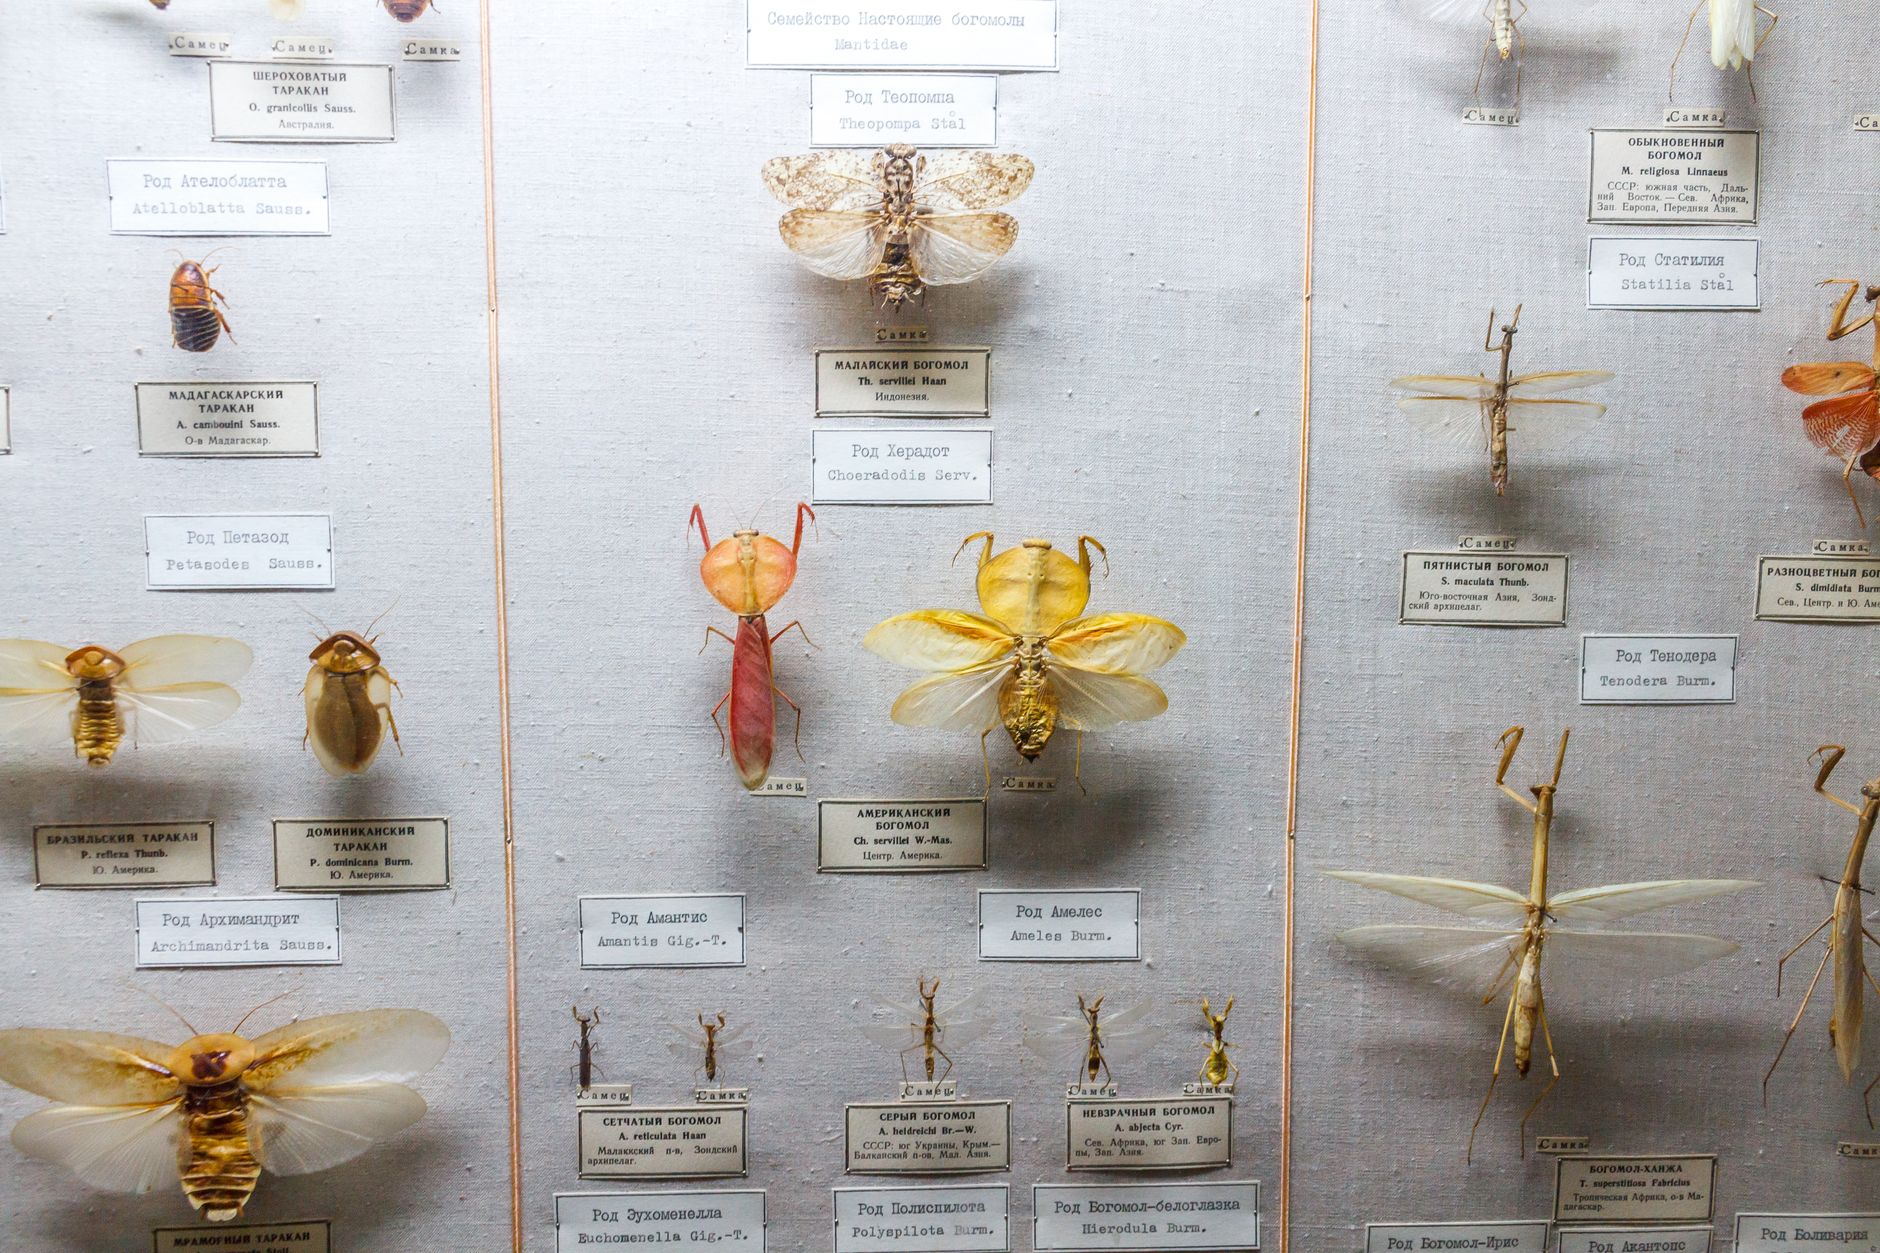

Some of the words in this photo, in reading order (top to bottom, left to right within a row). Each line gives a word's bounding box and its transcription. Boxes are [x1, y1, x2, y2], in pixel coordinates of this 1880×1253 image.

[767, 11, 850, 26] Семейство
[859, 11, 942, 27] Настоящие
[951, 12, 1025, 27] богомолы
[174, 36, 227, 52] Самец
[274, 40, 326, 55] Самец
[407, 42, 457, 55] Самка
[835, 38, 908, 51] Mantidae
[253, 71, 347, 82] ШЕРОХОВАТЫЙ
[272, 86, 329, 96] ТАРАКАН
[845, 90, 873, 105] Род
[881, 90, 955, 104] Теопомпа
[266, 103, 318, 115] granicollis
[324, 104, 356, 113] Sauss.
[1468, 110, 1514, 124] Самец
[1670, 111, 1718, 122] Самка
[278, 119, 335, 131] Австралия.
[839, 118, 921, 132] Theopompa
[1628, 137, 1725, 148] ОБЫКНОВЕННЫЙ
[1648, 151, 1702, 161] БОГОМОЛ
[1640, 167, 1680, 177] religiosa
[1687, 167, 1728, 177] Linnaeus
[143, 174, 172, 189] Род
[181, 174, 288, 188] Ателоблатта
[1607, 182, 1639, 191] СССР:
[1645, 184, 1678, 192] южная
[1683, 185, 1711, 193] часть,
[1721, 184, 1749, 193] Даль-
[1710, 194, 1749, 204] Африка,
[133, 202, 245, 214] Atelloblatta
[256, 203, 311, 216] Sauss.
[1622, 203, 1659, 214] Европа,
[1664, 203, 1709, 213] Передняя
[1713, 204, 1738, 214] Азия.
[1619, 253, 1646, 267] Род
[1654, 253, 1725, 267] Статилия
[1621, 279, 1691, 290] Statilia
[877, 329, 927, 340] Самка
[835, 361, 909, 371] МАЛАЙСКИЙ
[913, 361, 969, 370] БОГОМОЛ
[858, 377, 874, 386] Th.
[922, 377, 947, 385] Haan
[169, 390, 283, 401] МАДАГАСКАРСКИЙ
[875, 393, 929, 402] Индонезия.
[199, 404, 255, 413] ТАРАКАН
[193, 420, 243, 429] cambouini
[250, 419, 281, 429] Sauss.
[185, 436, 203, 445] О-в
[208, 437, 271, 446] Мадагаскар.
[851, 444, 879, 459] Род
[887, 444, 950, 460] Херадот
[828, 469, 926, 481] Choeradodis
[935, 470, 978, 481] Serv.
[187, 531, 215, 545] Род
[223, 531, 289, 545] Петазод
[1463, 537, 1512, 549] Самец
[1818, 541, 1863, 552] Самка
[166, 559, 250, 570] Petasodes
[268, 558, 322, 570] Sauss.
[1423, 561, 1491, 571] ПЯТНИСТЫЙ
[1497, 562, 1549, 572] БОГОМОЛ
[1767, 567, 1857, 578] РАЗНОЦВЕТНЫЙ
[1419, 591, 1488, 601] Юго-восточная
[1495, 593, 1520, 603] Азия,
[1803, 598, 1835, 608] Центр.
[1616, 650, 1642, 664] Род
[1650, 649, 1717, 665] Тенодера
[1600, 676, 1668, 687] Tenodera
[1676, 676, 1716, 686] Burm.
[1006, 778, 1053, 788] Самка
[857, 808, 951, 819] АМЕРИКАНСКИЙ
[876, 821, 930, 831] БОГОМОЛ
[306, 827, 415, 838] ДОМИНИКАНСКИЙ
[47, 833, 135, 845] БРАЗИЛЬСКИЙ
[142, 833, 198, 843] ТАРАКАН
[333, 843, 388, 851] ТАРАКАН
[96, 850, 129, 859] reflexa
[134, 849, 168, 858] Thunb.
[863, 852, 895, 862] Центр.
[900, 851, 943, 861] Америка.
[325, 858, 378, 866] dominicana
[384, 858, 413, 866] Burm.
[112, 866, 159, 876] Америка.
[349, 870, 394, 881] Америка.
[1016, 905, 1043, 919] Род
[1051, 906, 1103, 918] Амелес
[162, 913, 191, 928] Род
[200, 913, 300, 929] Архимандрит
[611, 912, 639, 926] Род
[647, 912, 708, 924] Амантис
[598, 936, 658, 947] Amantis
[667, 935, 727, 948] Gig.-T.
[1010, 930, 1062, 942] Ameles
[1071, 931, 1112, 941] Burm.
[151, 940, 269, 952] Archimandrita
[279, 939, 332, 950] Sauss.
[905, 1086, 952, 1096] Самец
[1070, 1085, 1115, 1096] Самец
[1185, 1084, 1233, 1094] Самка
[580, 1090, 627, 1101] Самец
[698, 1091, 744, 1101] Самка
[880, 1112, 917, 1122] СЕРЫЙ
[923, 1112, 976, 1121] БОГОМОЛ
[1082, 1108, 1156, 1118] НЕВЗРАЧНЫЙ
[1163, 1107, 1216, 1116] БОГОМОЛ
[603, 1117, 662, 1127] СЕТЧАТЫЙ
[668, 1117, 721, 1125] БОГОМОЛ
[1129, 1123, 1161, 1132] abjecta
[633, 1132, 677, 1140] reticulata
[682, 1132, 707, 1140] Haan
[1084, 1139, 1105, 1147] Сев.
[1110, 1139, 1149, 1148] Африка,
[1171, 1137, 1191, 1145] Зап.
[1196, 1135, 1222, 1146] Евро-
[597, 1147, 654, 1155] Малаккский
[694, 1145, 738, 1155] Зондский
[862, 1142, 894, 1150] СССР:
[915, 1142, 958, 1151] Украины,
[1541, 1139, 1586, 1150] Самка
[854, 1151, 908, 1160] Балканский
[939, 1152, 962, 1160] Мал.
[967, 1150, 991, 1159] Азия.
[1095, 1149, 1114, 1157] Зап.
[1119, 1148, 1144, 1156] Азия.
[588, 1157, 637, 1166] архипелаг.
[1589, 1165, 1683, 1174] БОГОМОЛ-ХАНЖА
[1631, 1193, 1667, 1204] Африка,
[858, 1203, 884, 1217] Род
[891, 1202, 986, 1215] Полиспилота
[1054, 1201, 1081, 1215] Род
[1089, 1200, 1240, 1214] Богомол-белоглазка
[592, 1209, 619, 1223] Род
[627, 1208, 722, 1222] Эухоменелла
[852, 1226, 944, 1240] Polyspilota
[954, 1225, 995, 1236] Burm.
[1082, 1223, 1157, 1235] Hierodula
[1167, 1223, 1207, 1233] Burm.
[256, 1232, 310, 1243] ТАРАКАН
[578, 1232, 681, 1244] Euchomenella
[690, 1230, 749, 1243] Gig.-T.
[1761, 1228, 1787, 1241] Род
[1794, 1228, 1868, 1243] Боливария
[1388, 1238, 1413, 1250] Род
[1421, 1236, 1520, 1250] Богомол-Ирис
[1588, 1241, 1614, 1253] Род
[1621, 1241, 1686, 1253] Акантопс
